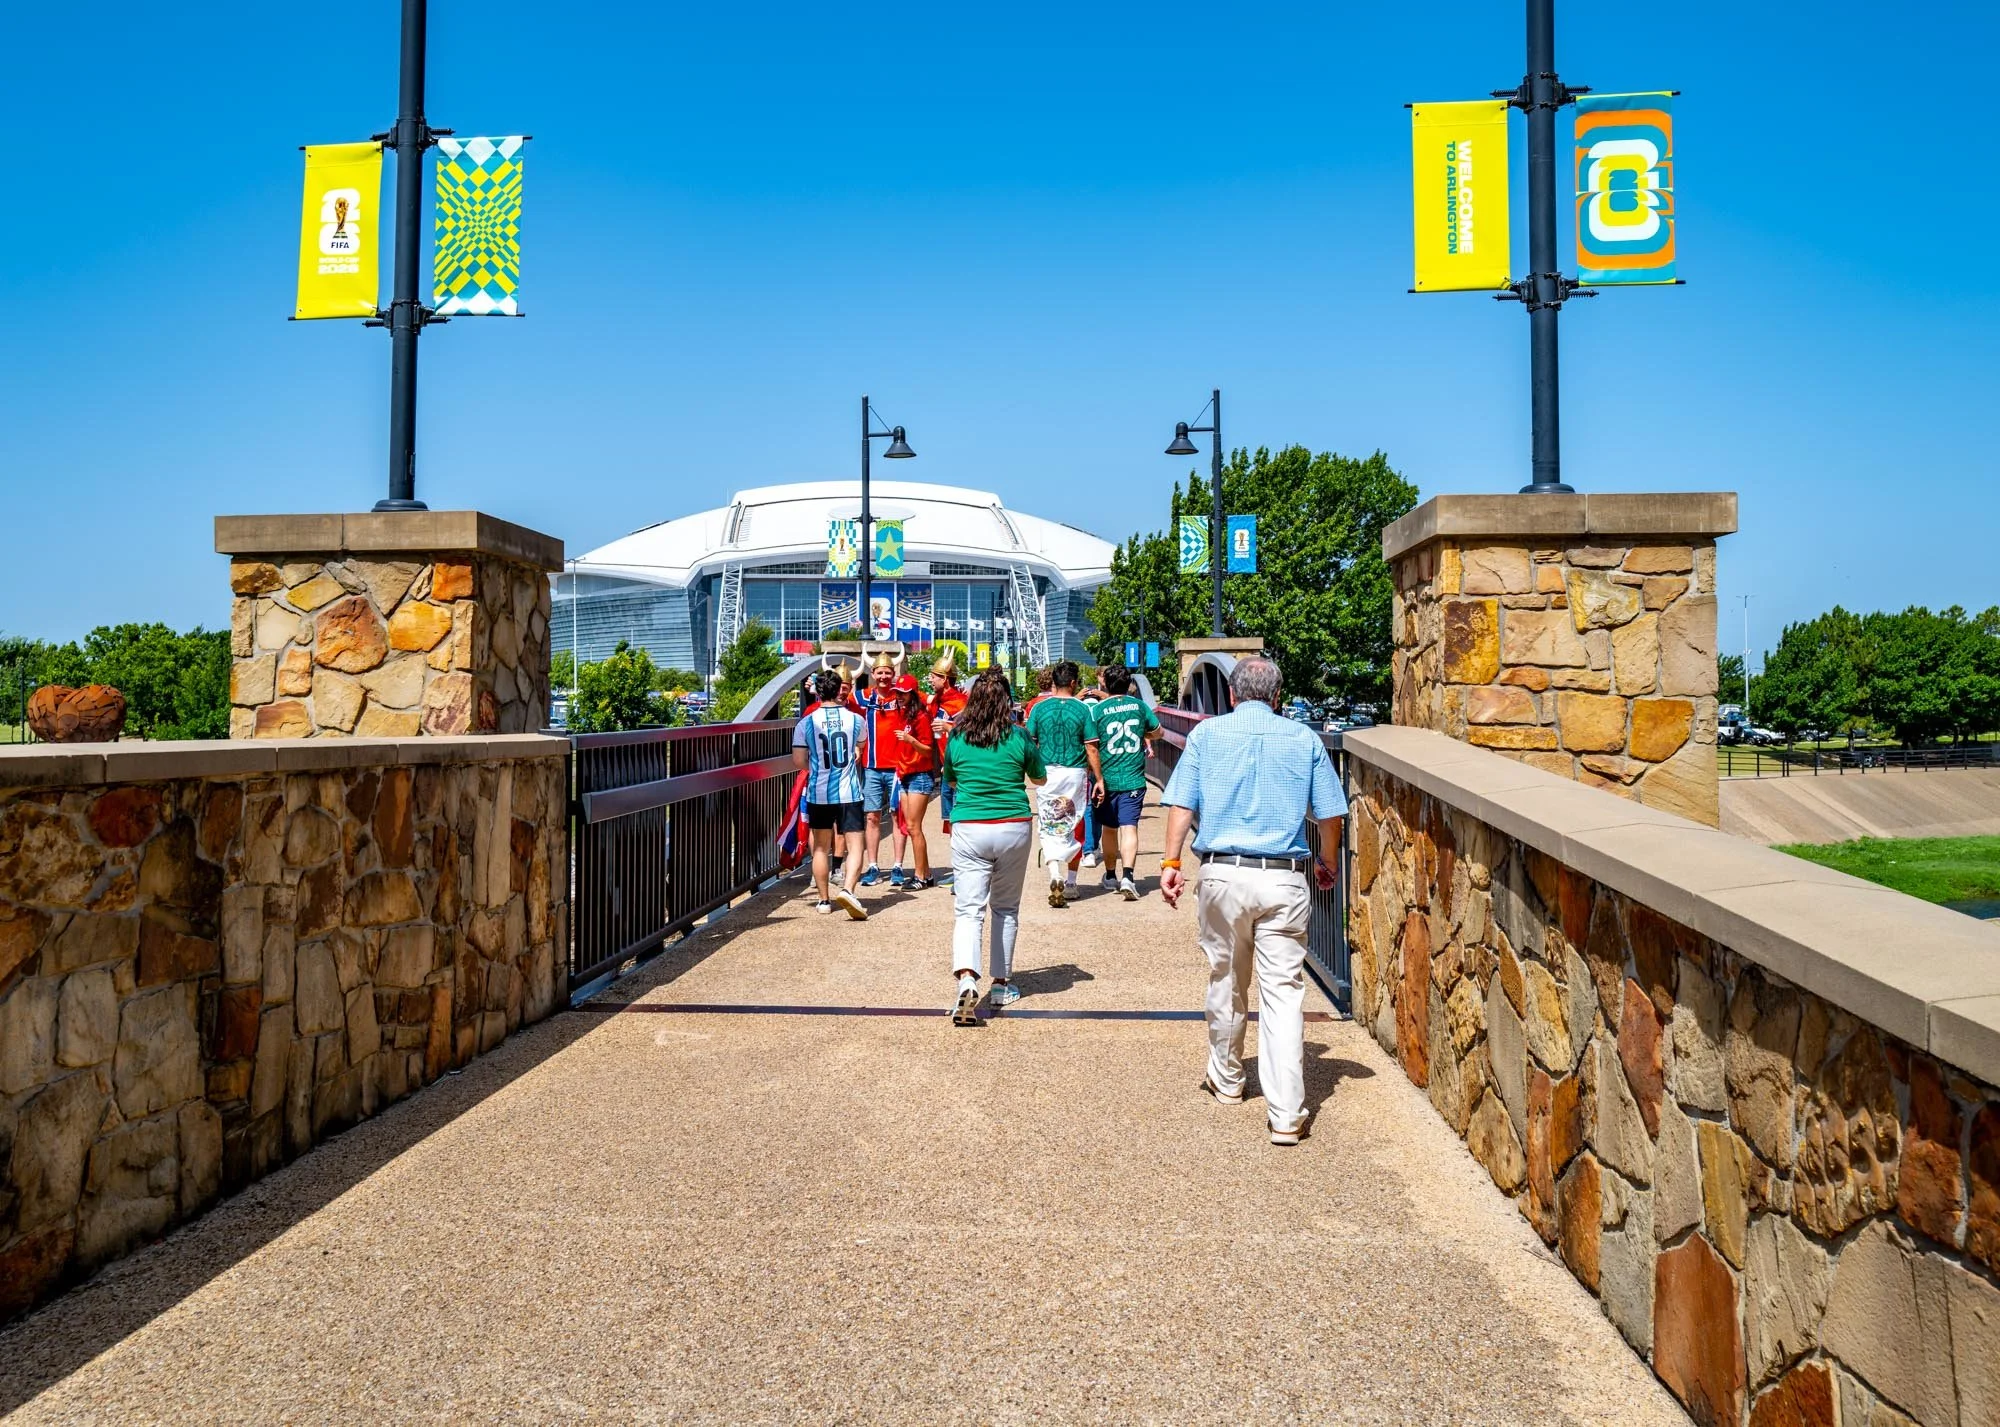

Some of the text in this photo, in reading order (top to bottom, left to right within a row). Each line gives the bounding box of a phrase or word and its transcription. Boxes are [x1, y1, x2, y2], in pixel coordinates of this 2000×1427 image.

[1447, 141, 1457, 254] TO ARLINGTON
[1458, 140, 1473, 254] WELCOME
[822, 720, 843, 729] MESSI
[1106, 719, 1140, 754] 25
[819, 731, 848, 769] 10
